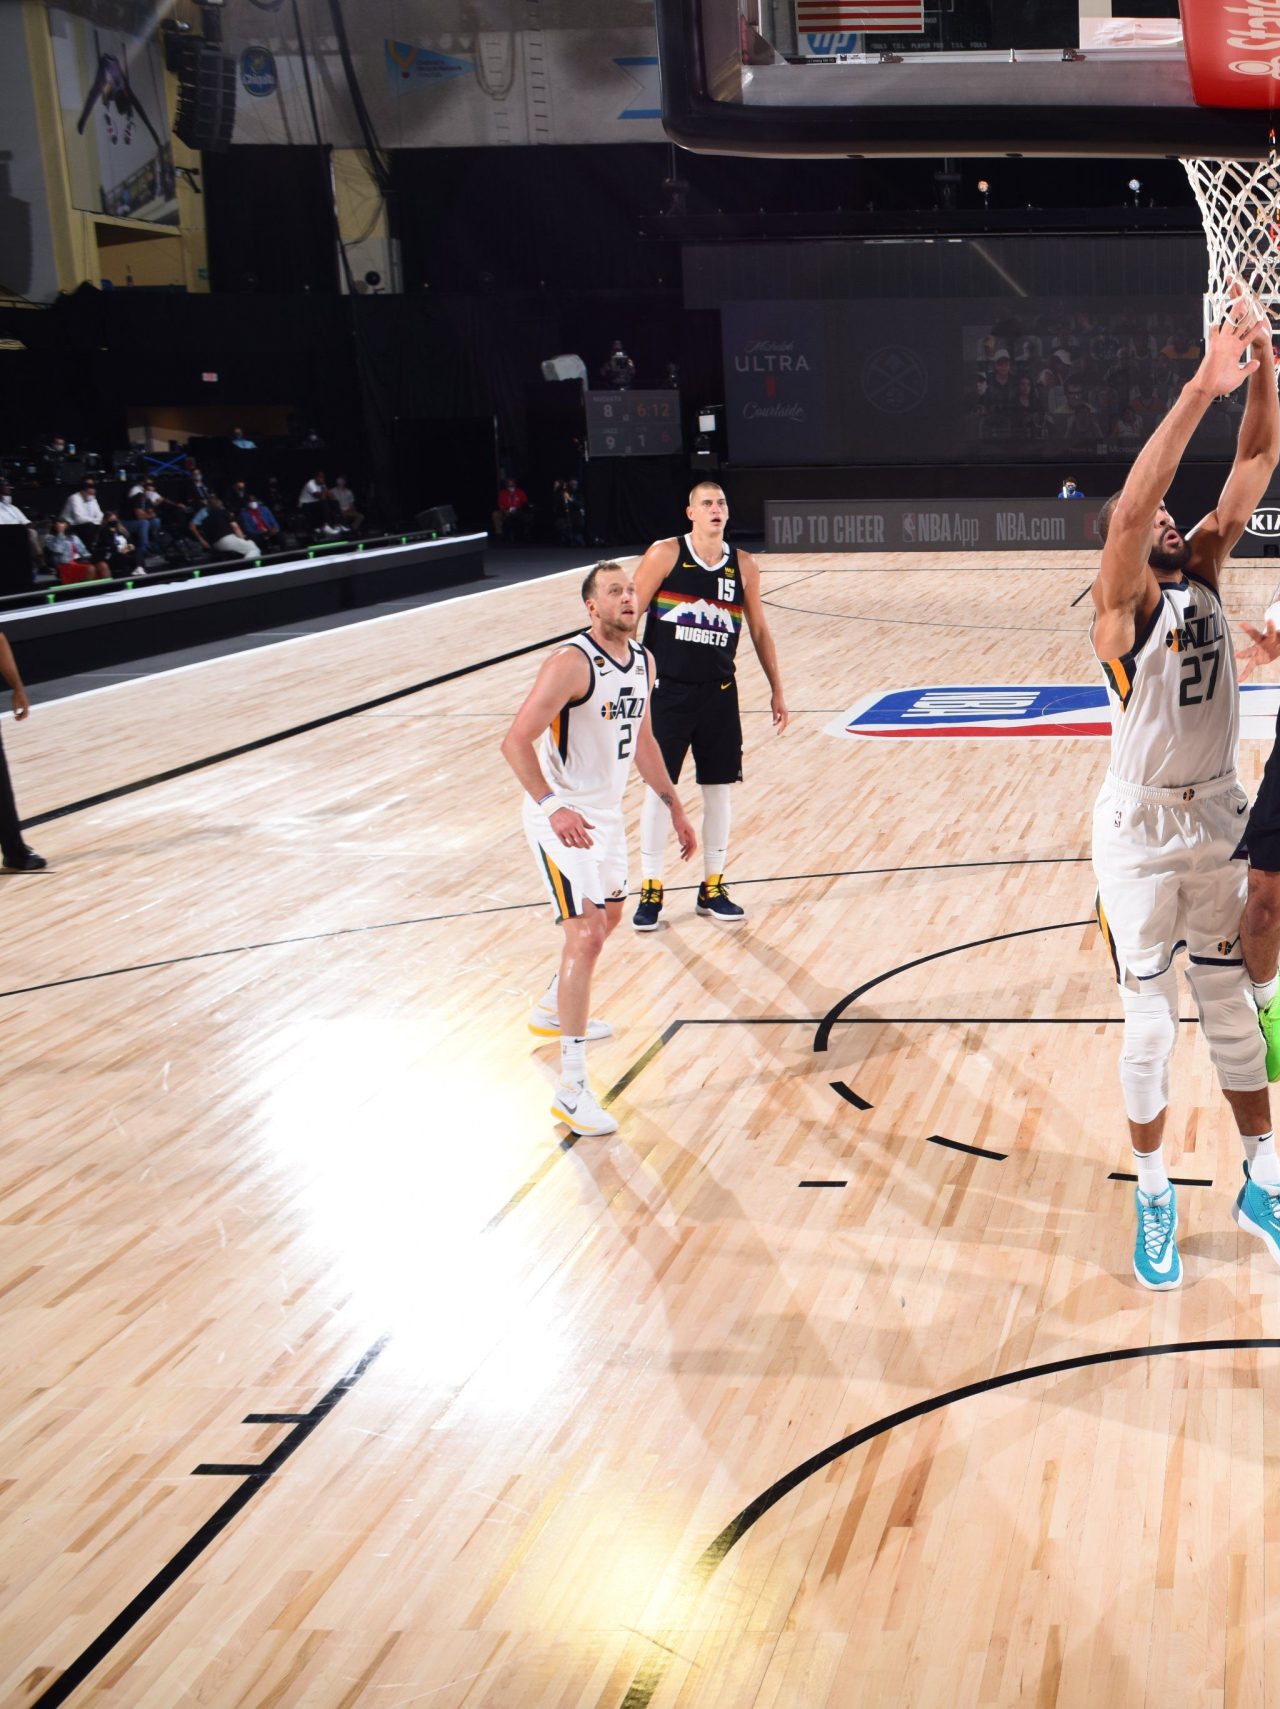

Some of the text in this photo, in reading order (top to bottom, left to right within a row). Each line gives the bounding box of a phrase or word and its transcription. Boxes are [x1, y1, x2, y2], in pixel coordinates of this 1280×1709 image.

[734, 354, 810, 372] ULTRA
[603, 404, 613, 418] 8
[636, 402, 671, 417] 6:12
[605, 436, 616, 450] 9
[772, 516, 803, 544] TAP
[808, 515, 829, 544] TO
[833, 514, 885, 543] CHEER
[918, 513, 950, 542] NBA
[954, 513, 979, 547] App
[996, 512, 1066, 541] NBA.com
[717, 578, 736, 602] 15
[676, 624, 729, 647] NUGGETS
[1179, 649, 1220, 706] 27
[617, 723, 632, 760] 2
